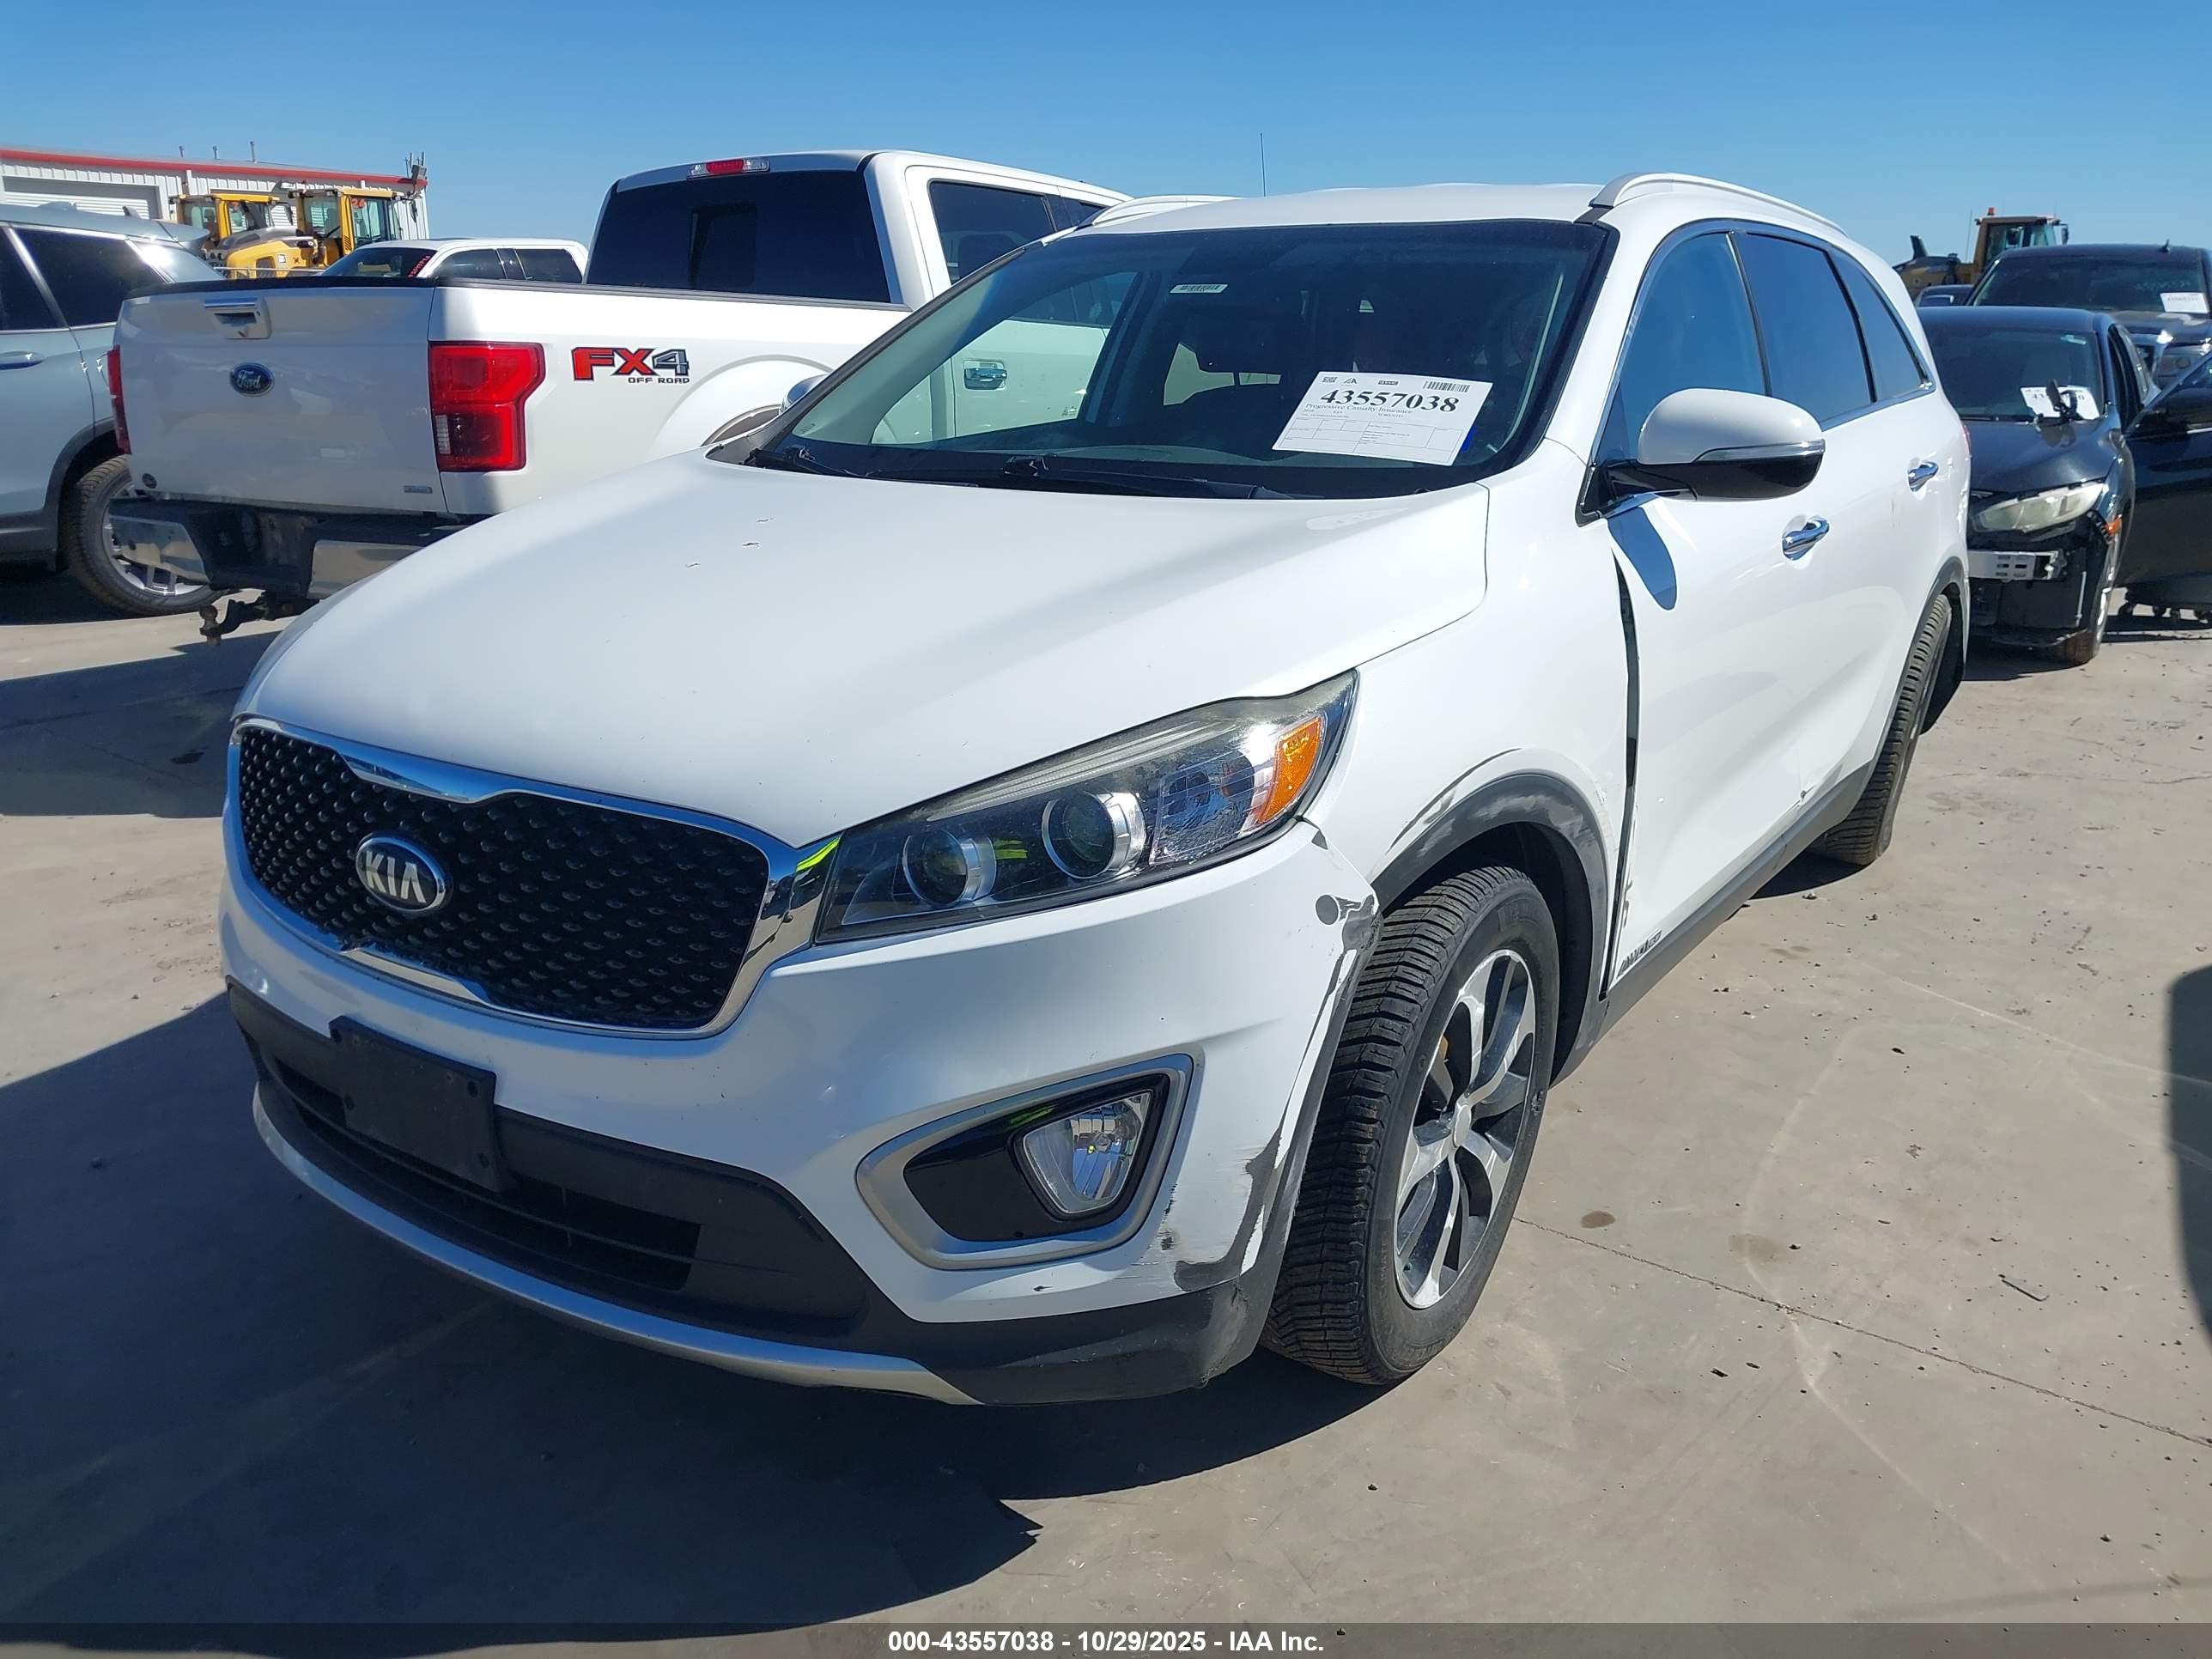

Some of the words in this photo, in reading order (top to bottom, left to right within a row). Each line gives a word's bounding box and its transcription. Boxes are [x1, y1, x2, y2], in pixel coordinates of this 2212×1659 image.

[571, 347, 690, 381] FX4
[1321, 389, 1460, 413] 43557038
[366, 850, 427, 903] KIA
